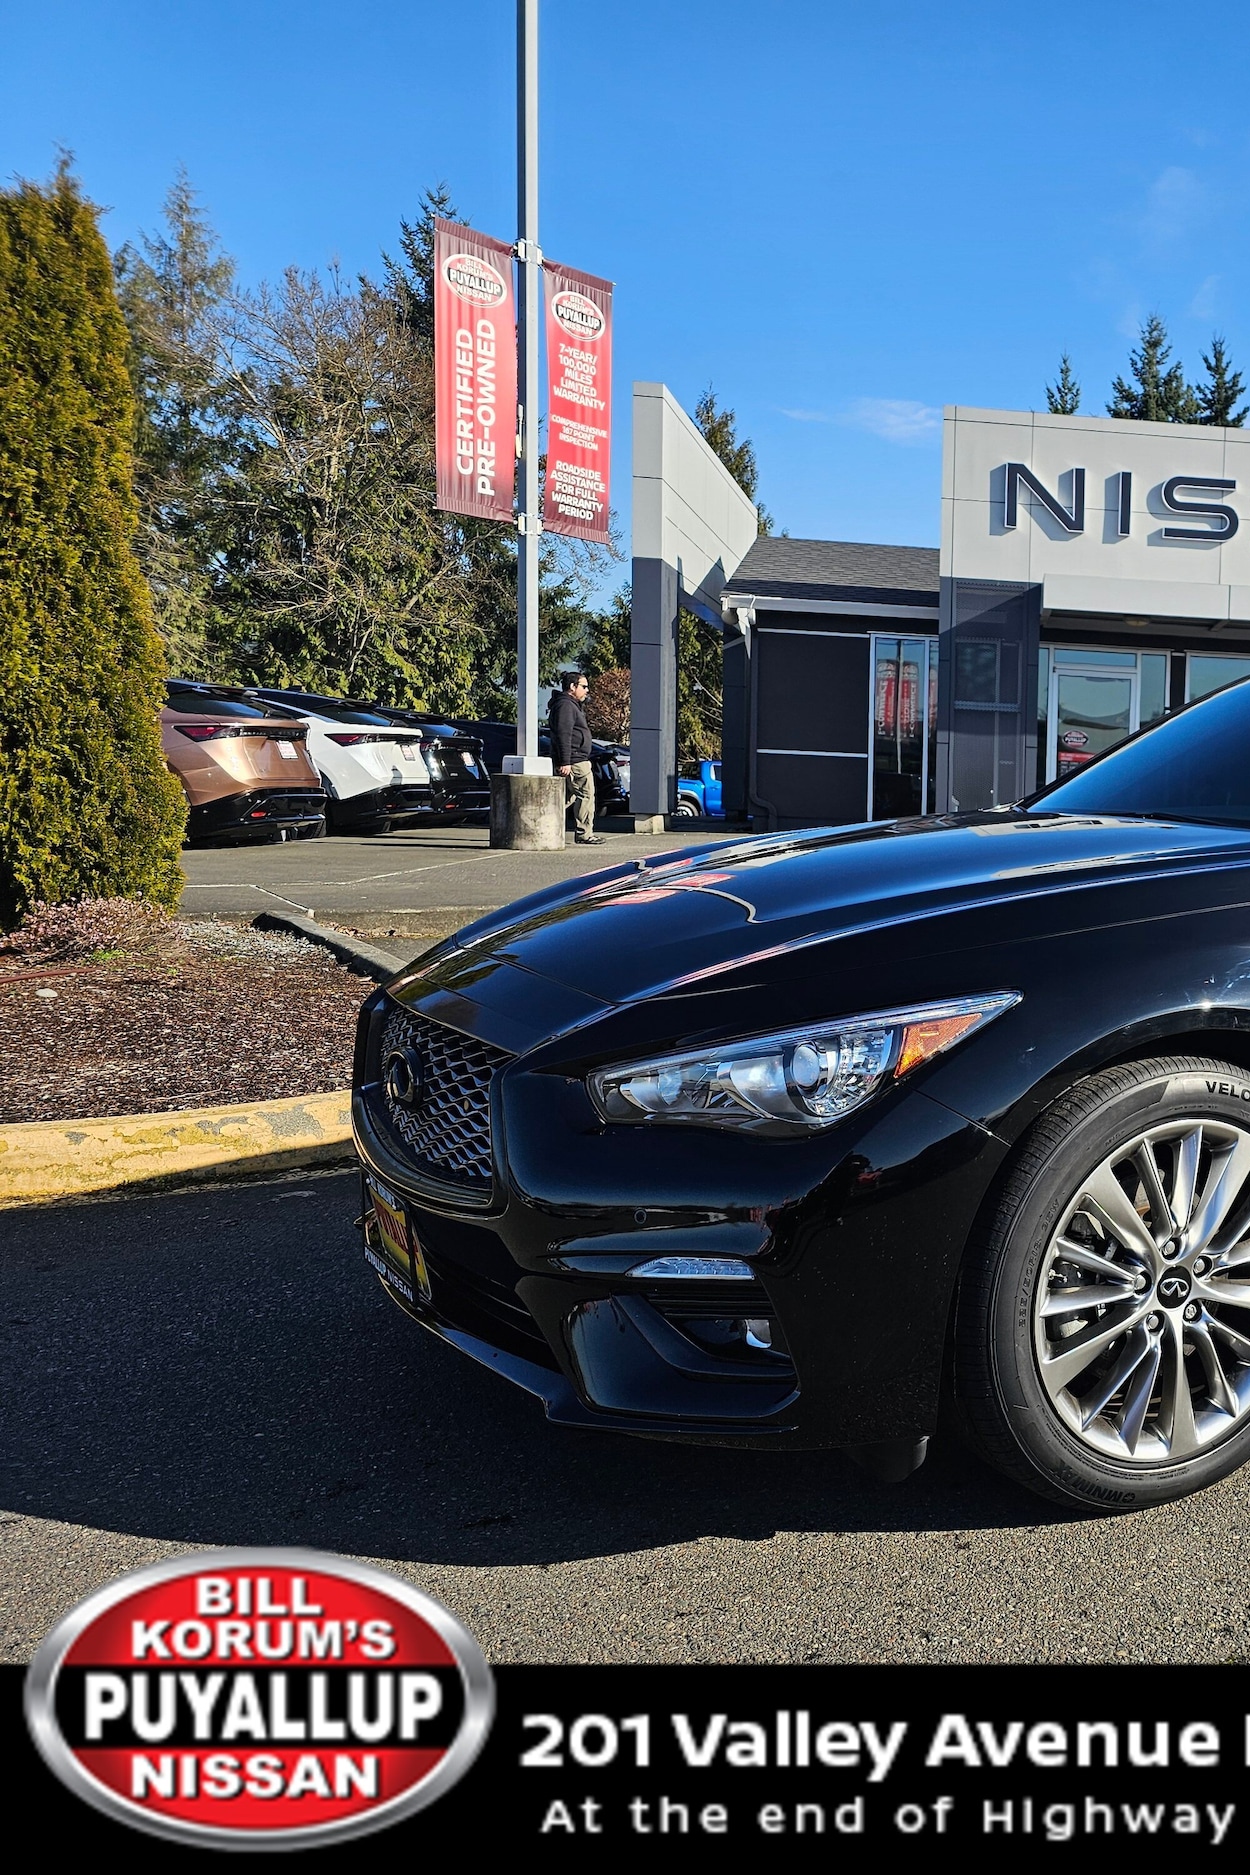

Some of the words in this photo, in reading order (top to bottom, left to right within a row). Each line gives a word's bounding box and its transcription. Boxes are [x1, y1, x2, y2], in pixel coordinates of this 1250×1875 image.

[449, 268, 502, 295] PUYALLUP
[456, 284, 492, 302] NISSAN
[557, 304, 600, 330] PUYALLUP
[563, 319, 593, 336] NISSAN
[559, 342, 598, 365] 7-YEAR/
[558, 354, 597, 376] 100,000
[564, 367, 593, 385] MILES
[560, 376, 597, 397] LIMITED
[456, 329, 474, 475] CERTIFIED
[476, 319, 496, 496] PRE-OWNED
[553, 385, 606, 411] WARRANTY
[551, 414, 608, 439] COMPREHENSIVE
[573, 429, 595, 442] POINT
[559, 432, 599, 451] INSPECTION
[550, 470, 606, 493] ASSISTANCE
[555, 460, 601, 481] ROADSIDE
[551, 491, 604, 513] WARRANTY
[555, 483, 575, 497] FOR
[574, 487, 598, 502] FULL
[558, 503, 594, 521] PERIOD
[387, 1268, 414, 1302] NISSAN
